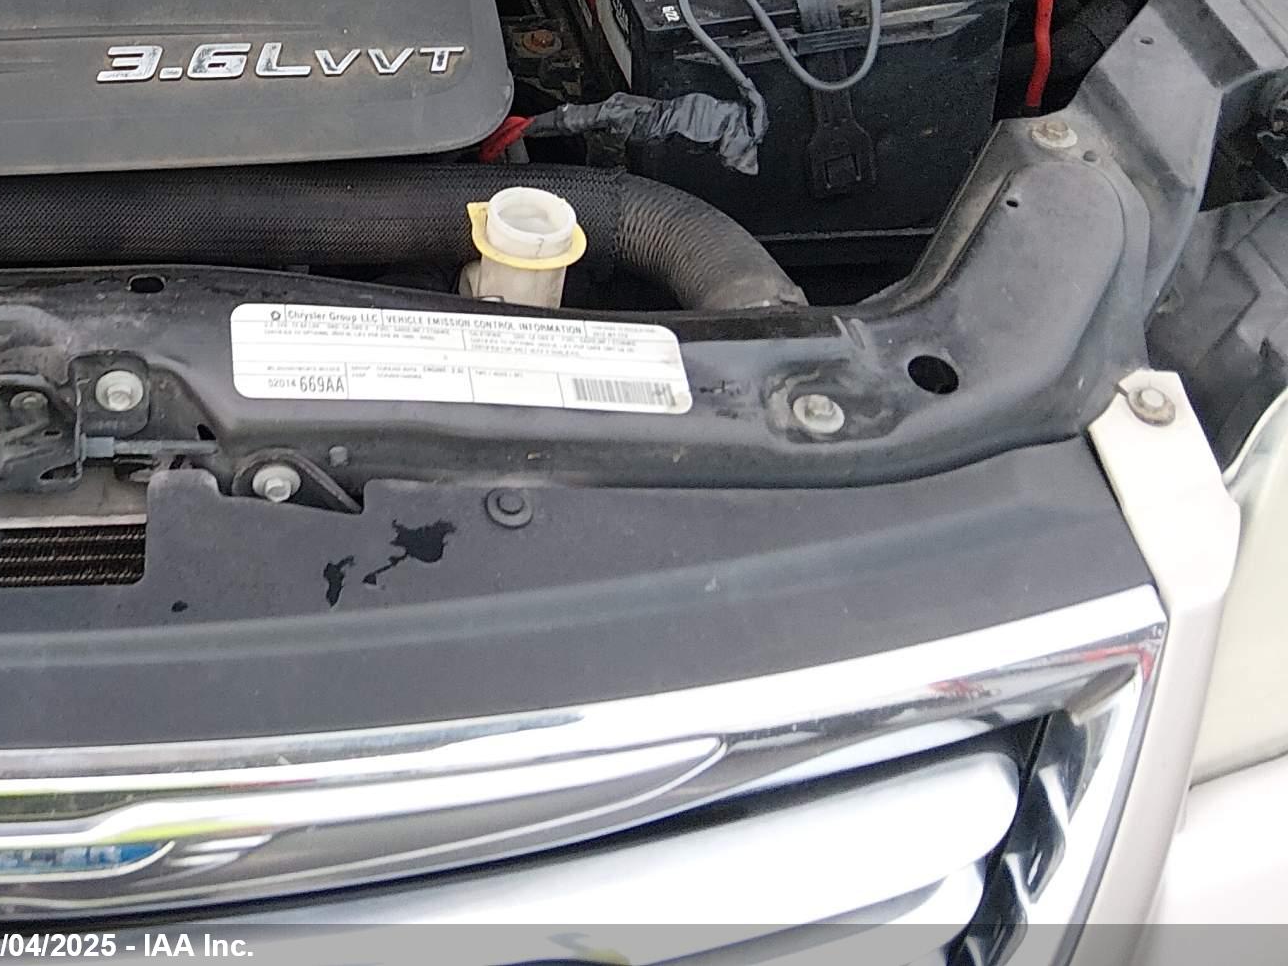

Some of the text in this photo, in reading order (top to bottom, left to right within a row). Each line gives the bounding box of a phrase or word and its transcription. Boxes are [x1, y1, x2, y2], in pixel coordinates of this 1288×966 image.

[96, 42, 466, 83] 3.6L VVT
[287, 310, 378, 324] Chrysler Group LLC
[386, 315, 424, 325] VEHICLE
[427, 317, 471, 328] EMISSION
[473, 321, 515, 331] CONTROL
[518, 322, 582, 334] INFORMATION
[299, 375, 345, 393] 669AA
